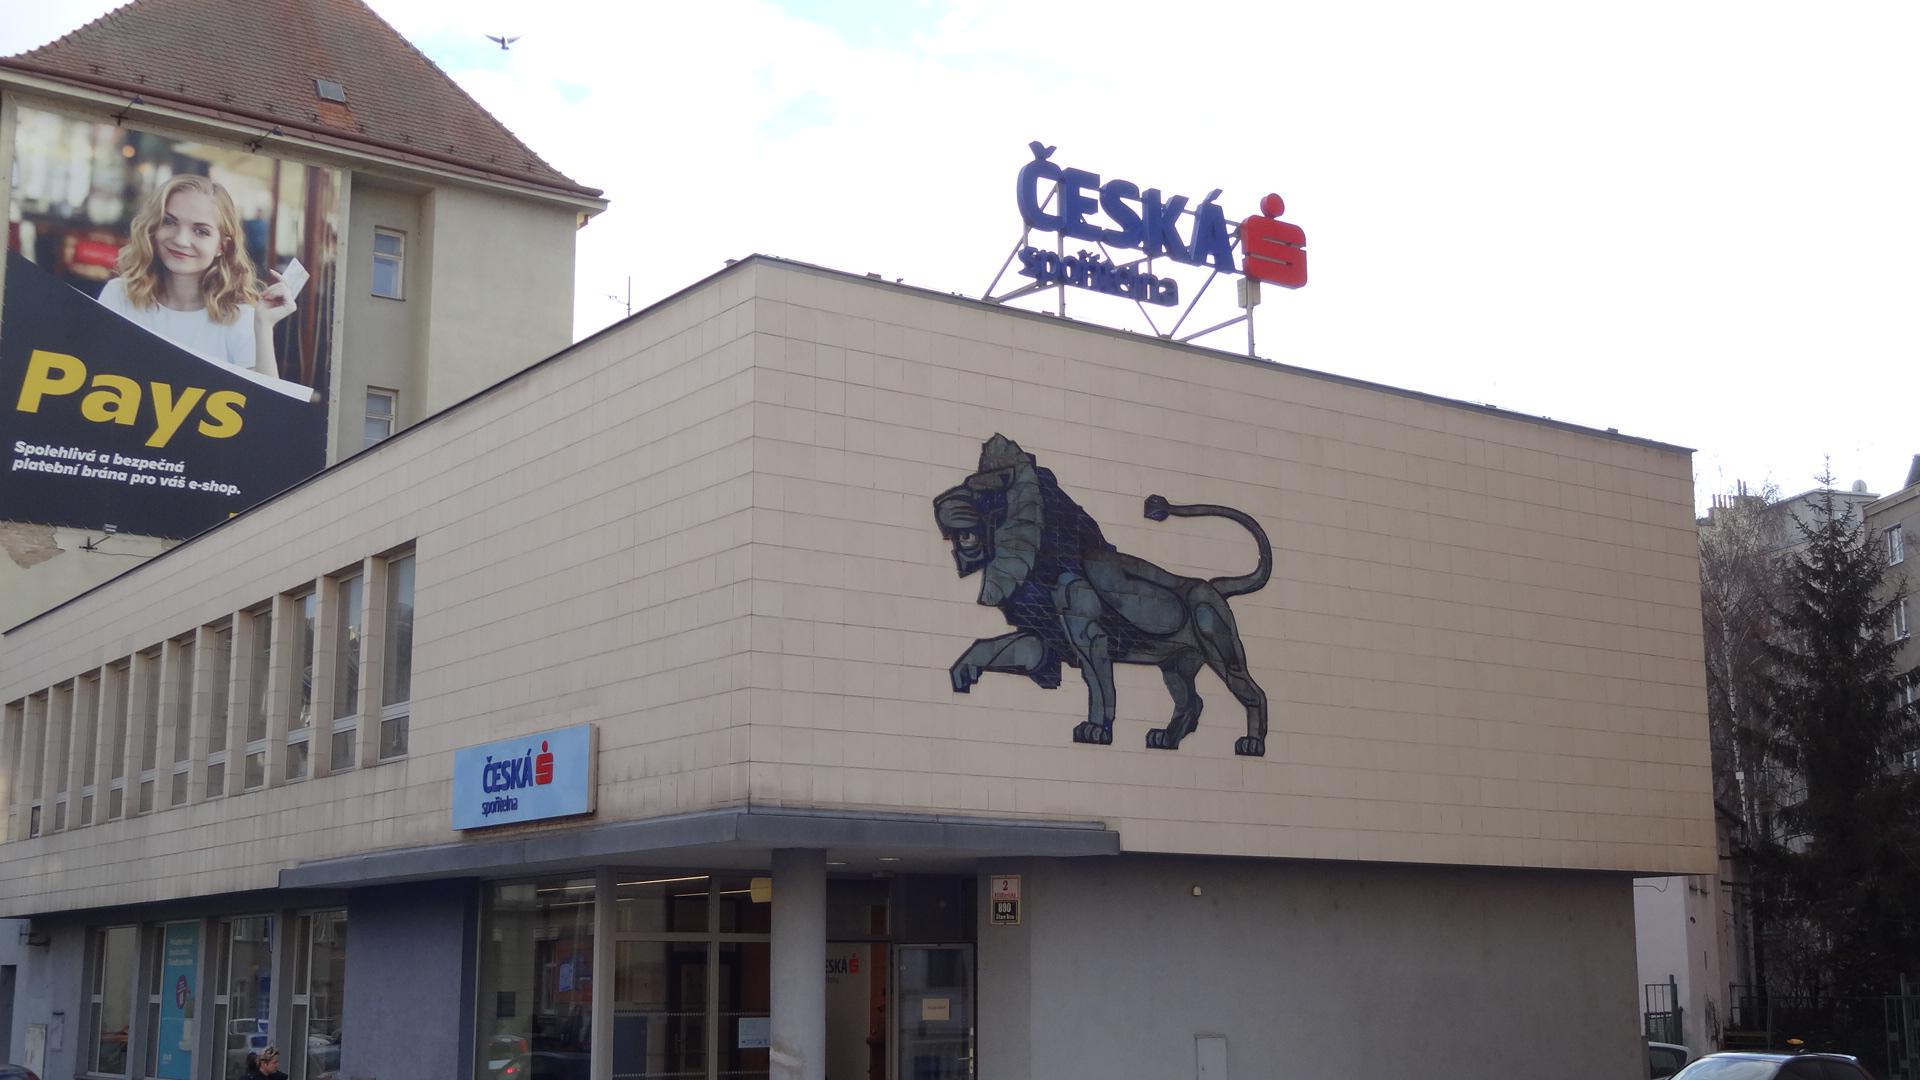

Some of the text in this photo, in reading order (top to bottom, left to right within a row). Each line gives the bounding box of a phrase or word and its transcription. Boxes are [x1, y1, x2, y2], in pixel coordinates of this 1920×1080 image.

[1017, 140, 1236, 275] ČESKÁ
[16, 349, 247, 448] Pays
[12, 458, 241, 496] platební brána pro váš e-shop.
[14, 440, 185, 473] Spolehlivá a bezpečná
[483, 748, 534, 794] ČESKÁ
[1002, 880, 1009, 891] 2
